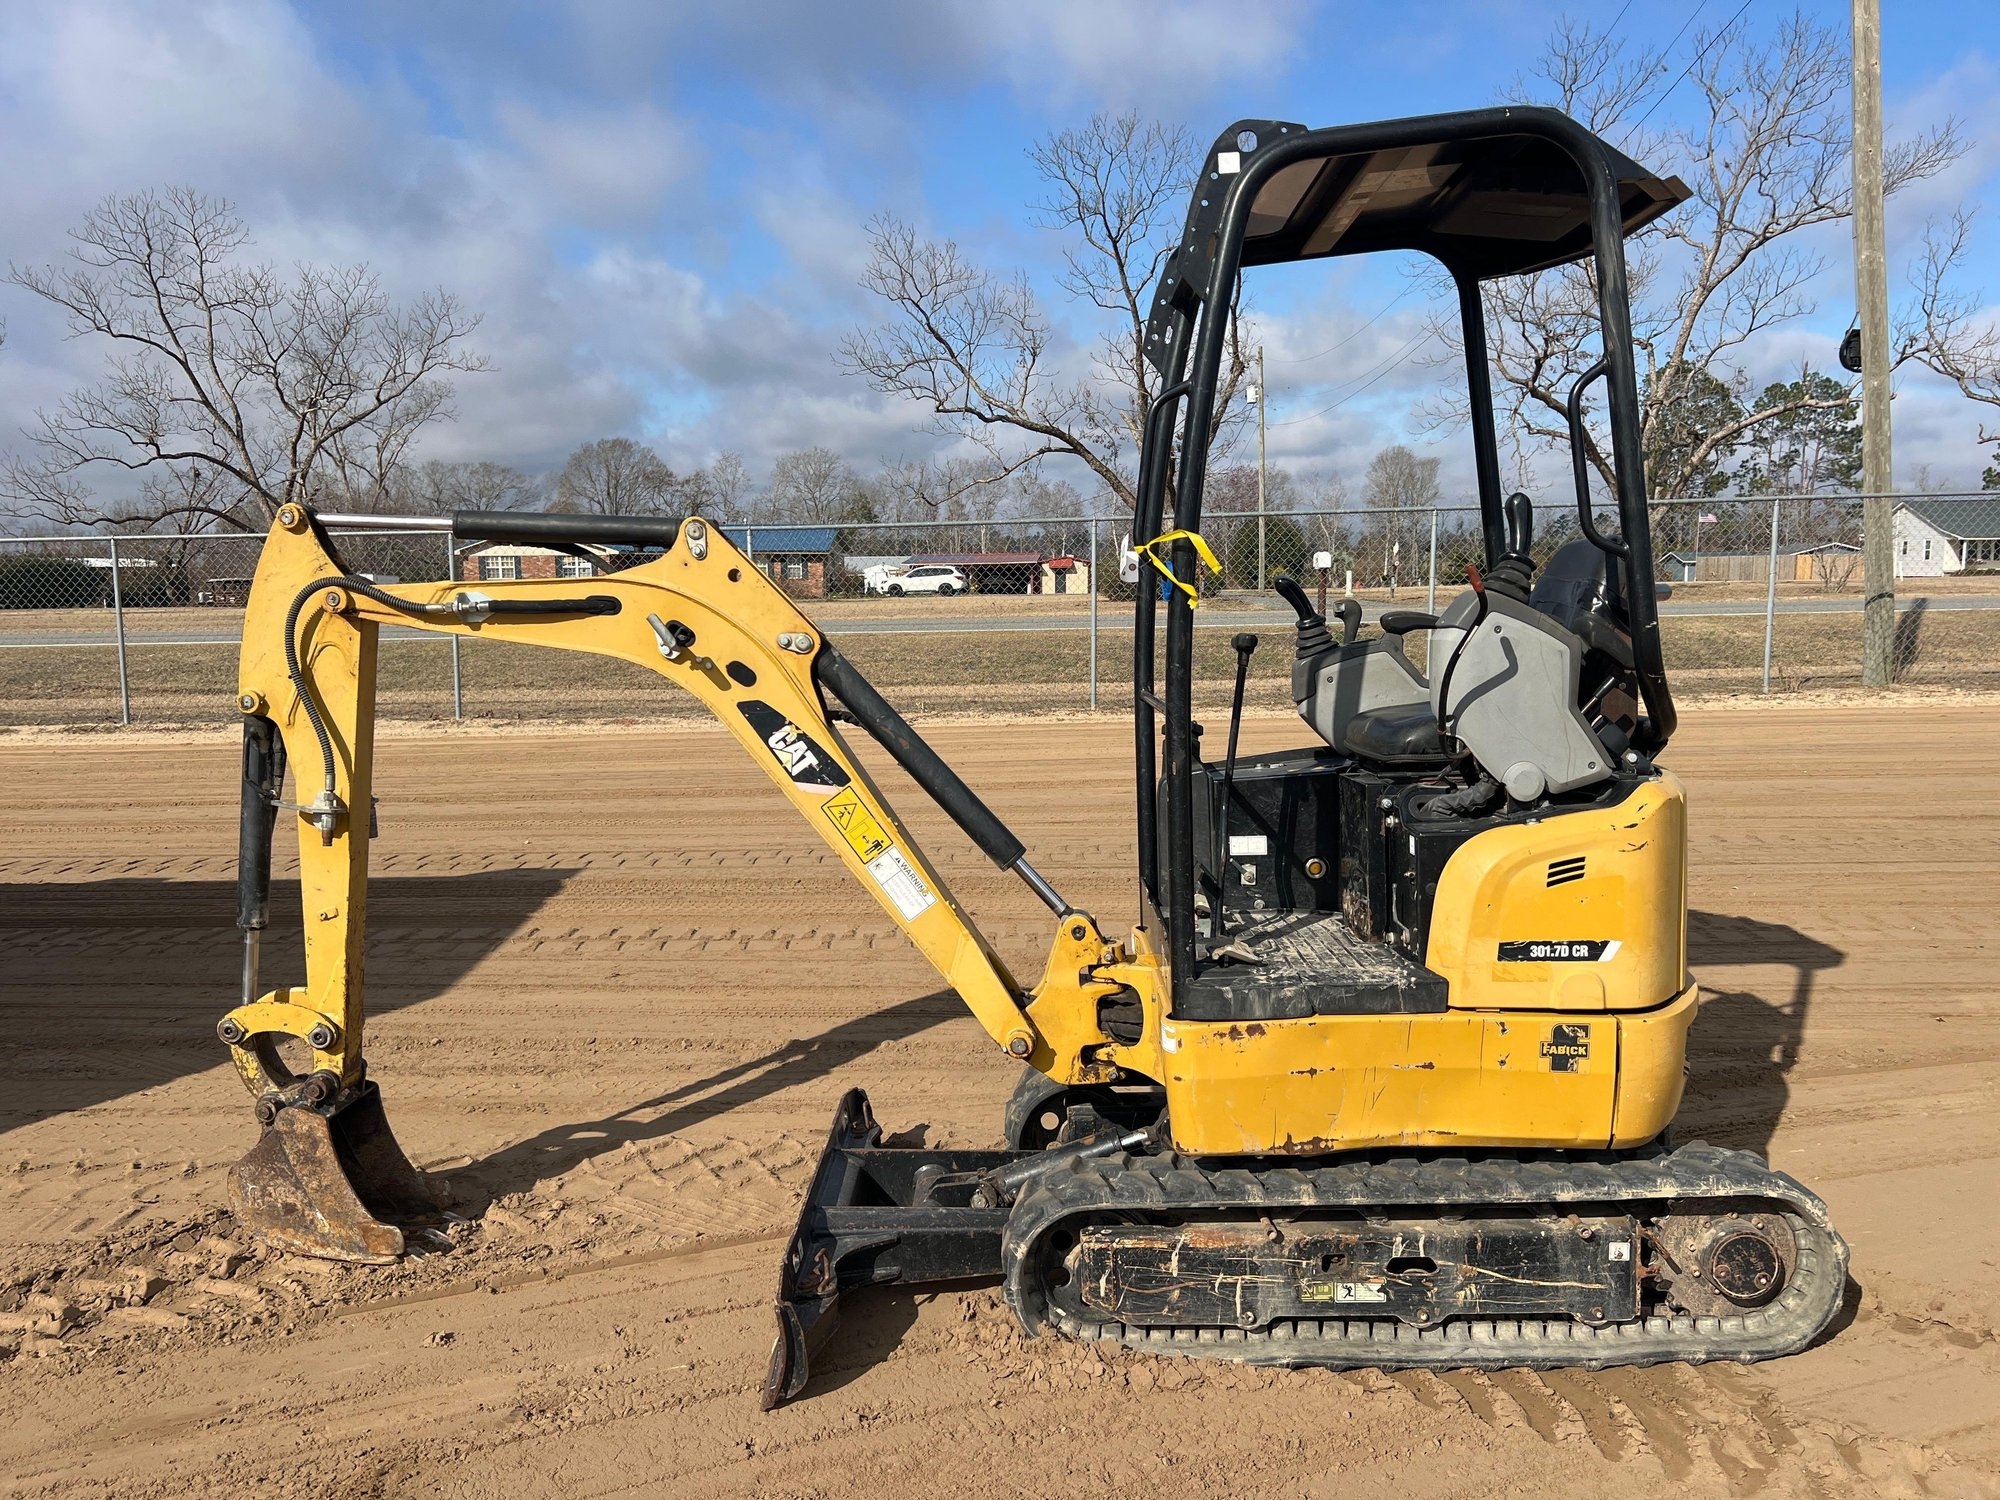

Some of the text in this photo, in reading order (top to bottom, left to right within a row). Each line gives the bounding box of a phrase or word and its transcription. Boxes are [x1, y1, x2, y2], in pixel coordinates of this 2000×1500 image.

[768, 725, 819, 777] CAT
[900, 861, 929, 898] WARNING
[1530, 944, 1589, 958] 301.7D CR
[1542, 1045, 1587, 1056] FABICK
